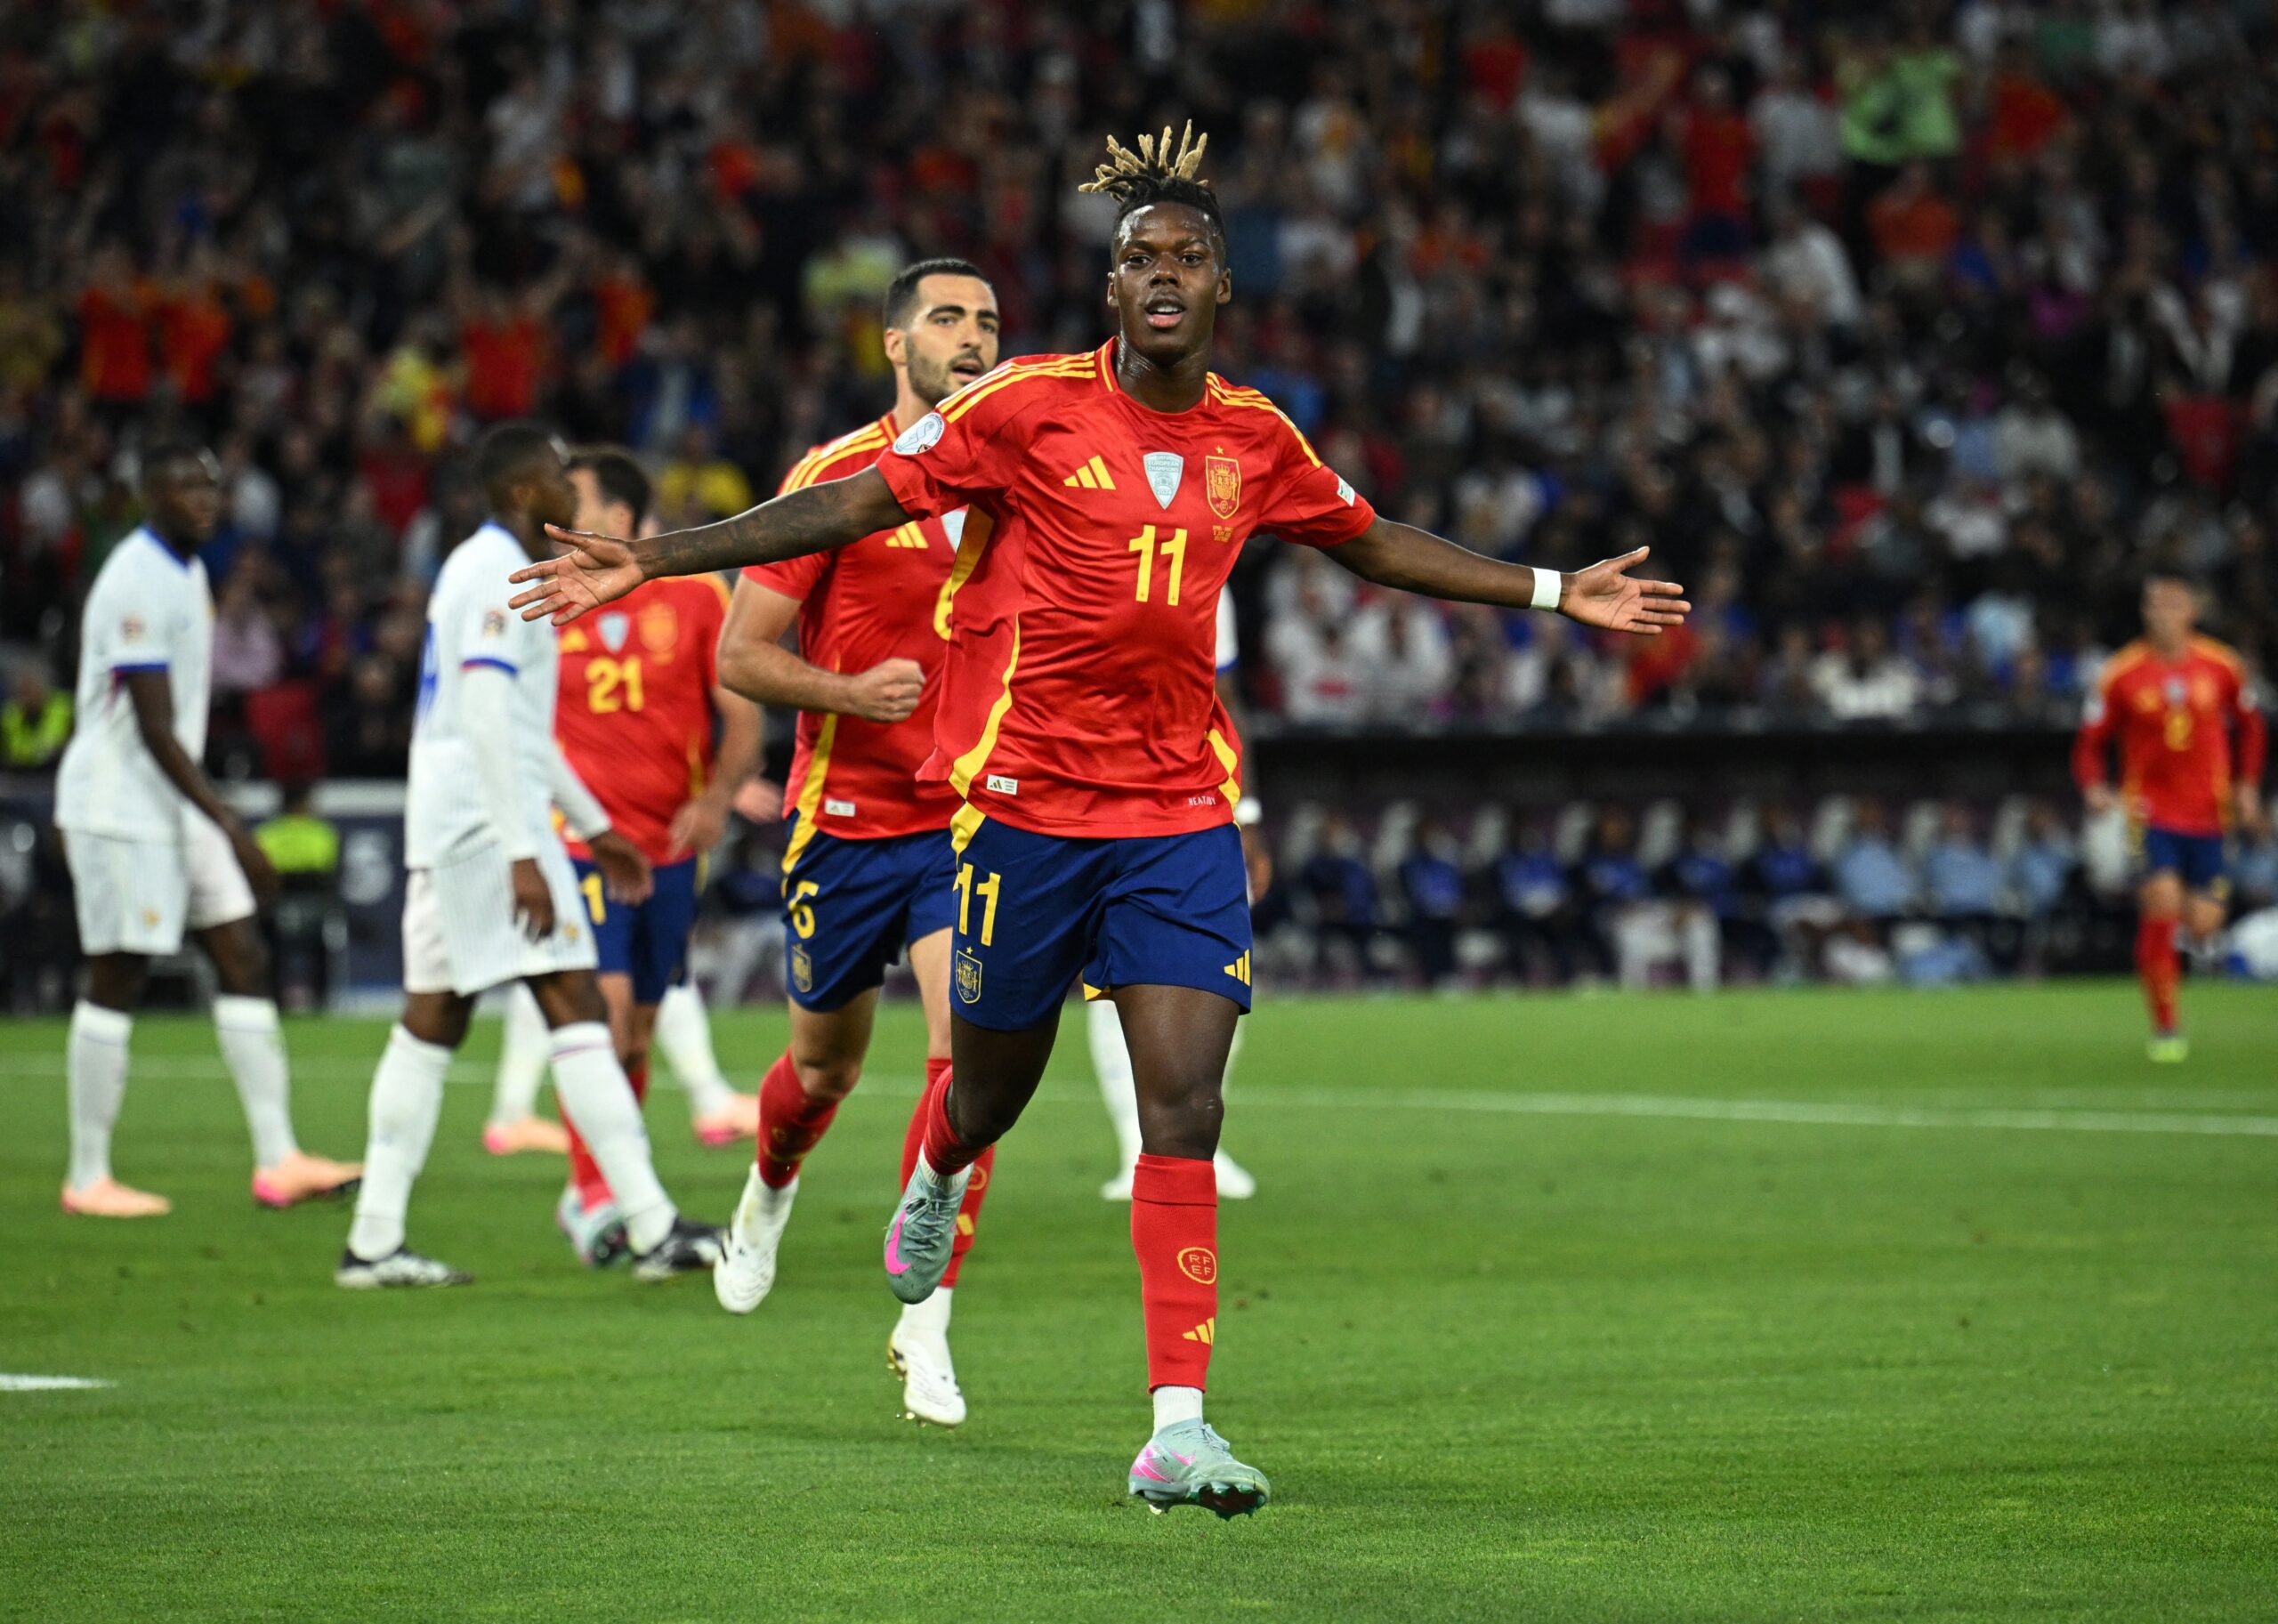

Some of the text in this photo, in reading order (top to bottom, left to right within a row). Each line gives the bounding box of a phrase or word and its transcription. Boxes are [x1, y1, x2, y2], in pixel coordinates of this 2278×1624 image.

[1128, 524, 1188, 607] 11
[585, 655, 645, 713] 21
[579, 871, 608, 925] 1
[788, 879, 820, 939] 6
[952, 862, 1001, 947] 11
[1189, 1254, 1211, 1264] RF
[1192, 1264, 1211, 1275] EF
